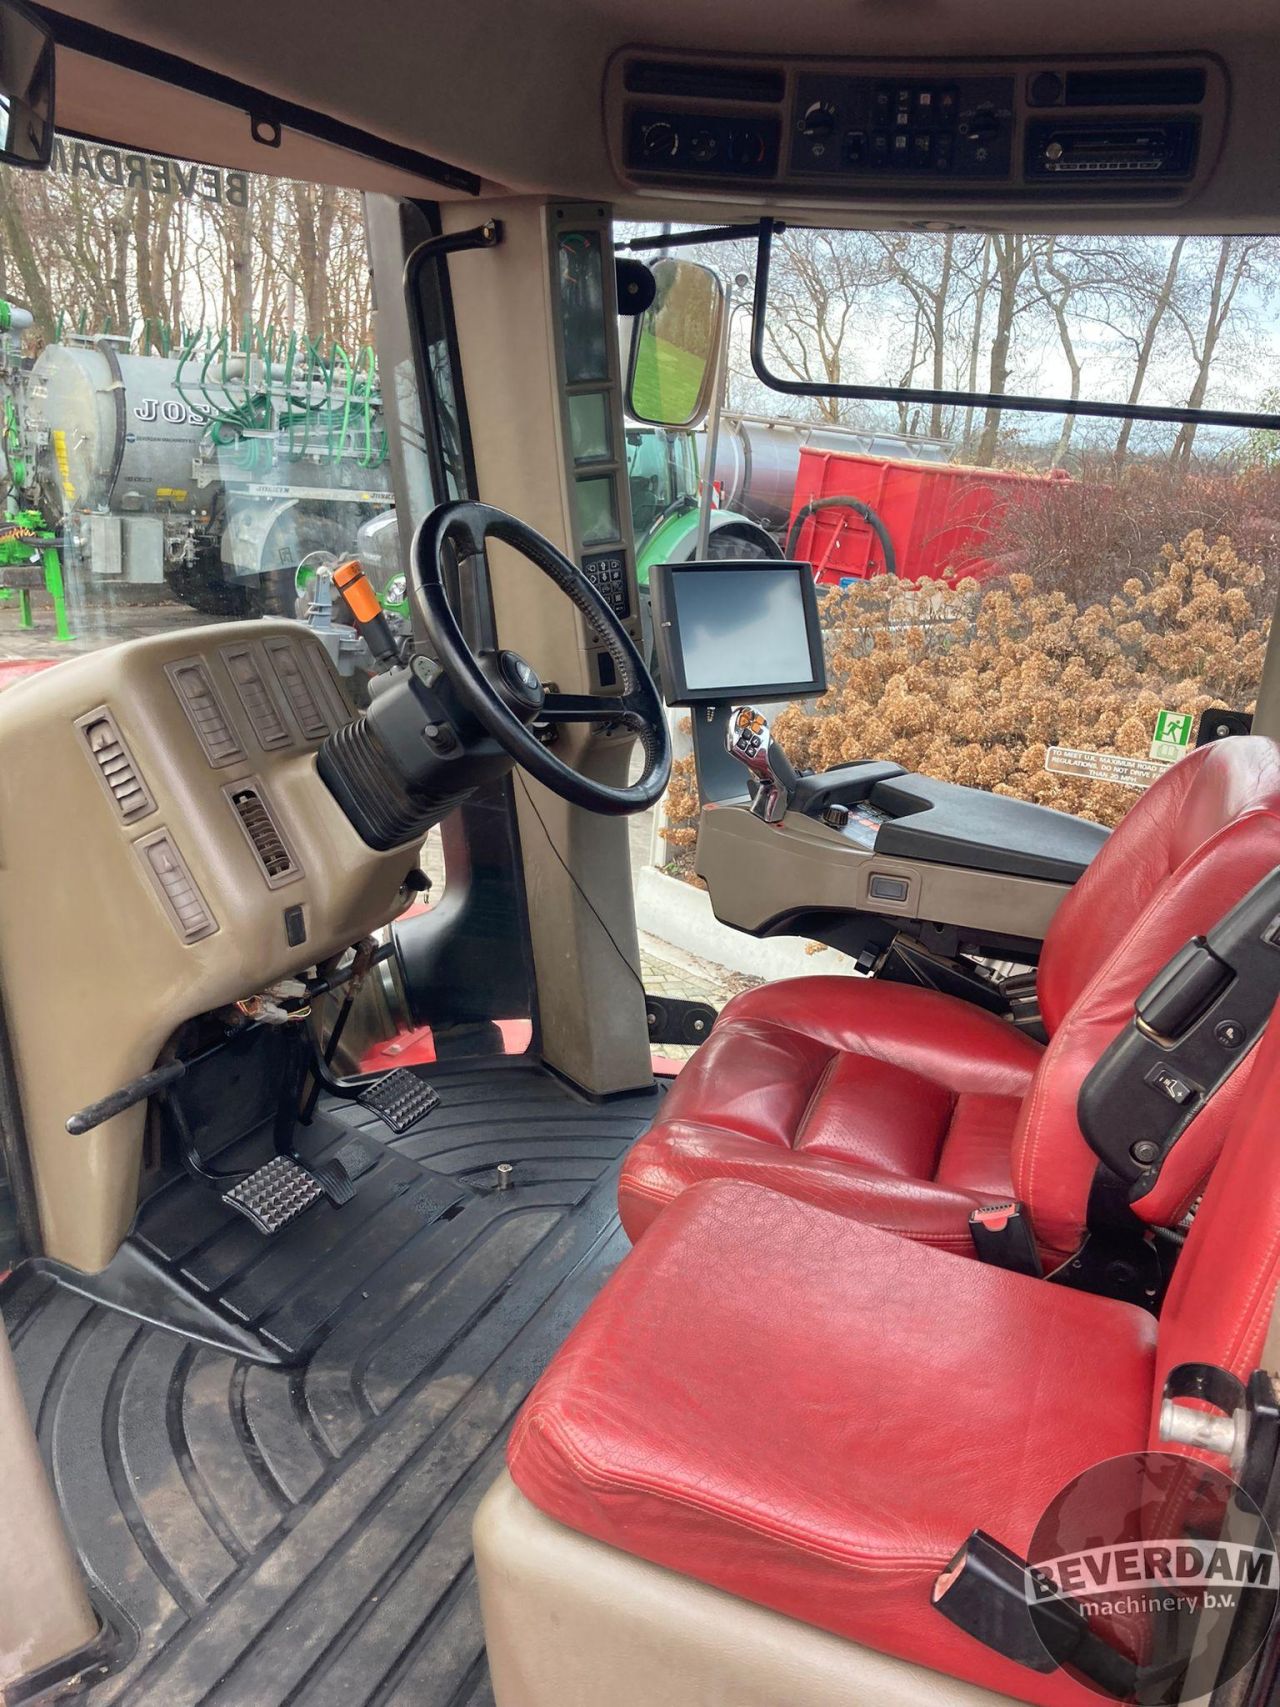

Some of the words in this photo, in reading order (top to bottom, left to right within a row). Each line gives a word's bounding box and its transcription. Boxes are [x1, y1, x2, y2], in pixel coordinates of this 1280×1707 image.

[1064, 751, 1083, 760] MEET
[1100, 757, 1136, 768] MAXIMUM
[1138, 763, 1157, 771] ROAD
[1089, 769, 1108, 778] THAN
[1120, 775, 1137, 783] MPH
[1113, 766, 1129, 775] NOT
[1130, 769, 1151, 778] DRIVE
